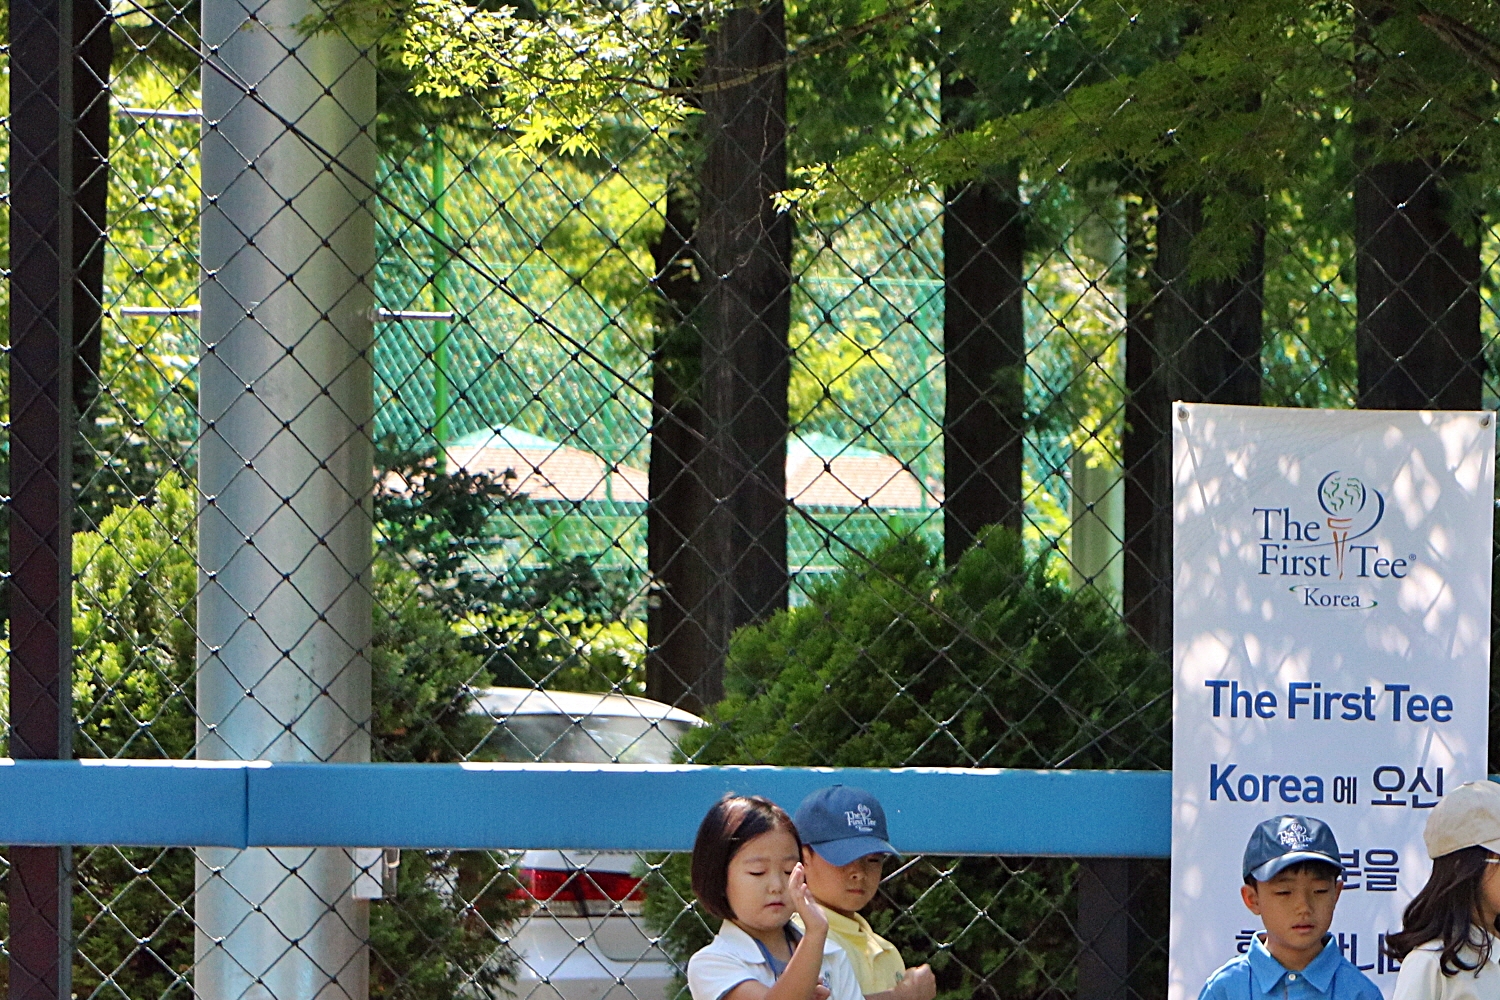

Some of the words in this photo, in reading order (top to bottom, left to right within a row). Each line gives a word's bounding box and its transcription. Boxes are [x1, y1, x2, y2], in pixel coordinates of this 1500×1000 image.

[1252, 507, 1320, 542] The
[1257, 543, 1331, 577] First
[1303, 586, 1361, 608] Korea
[1204, 679, 1277, 720] The
[1287, 681, 1376, 721] First
[1384, 683, 1454, 723] Tee
[1371, 765, 1444, 809] 오신
